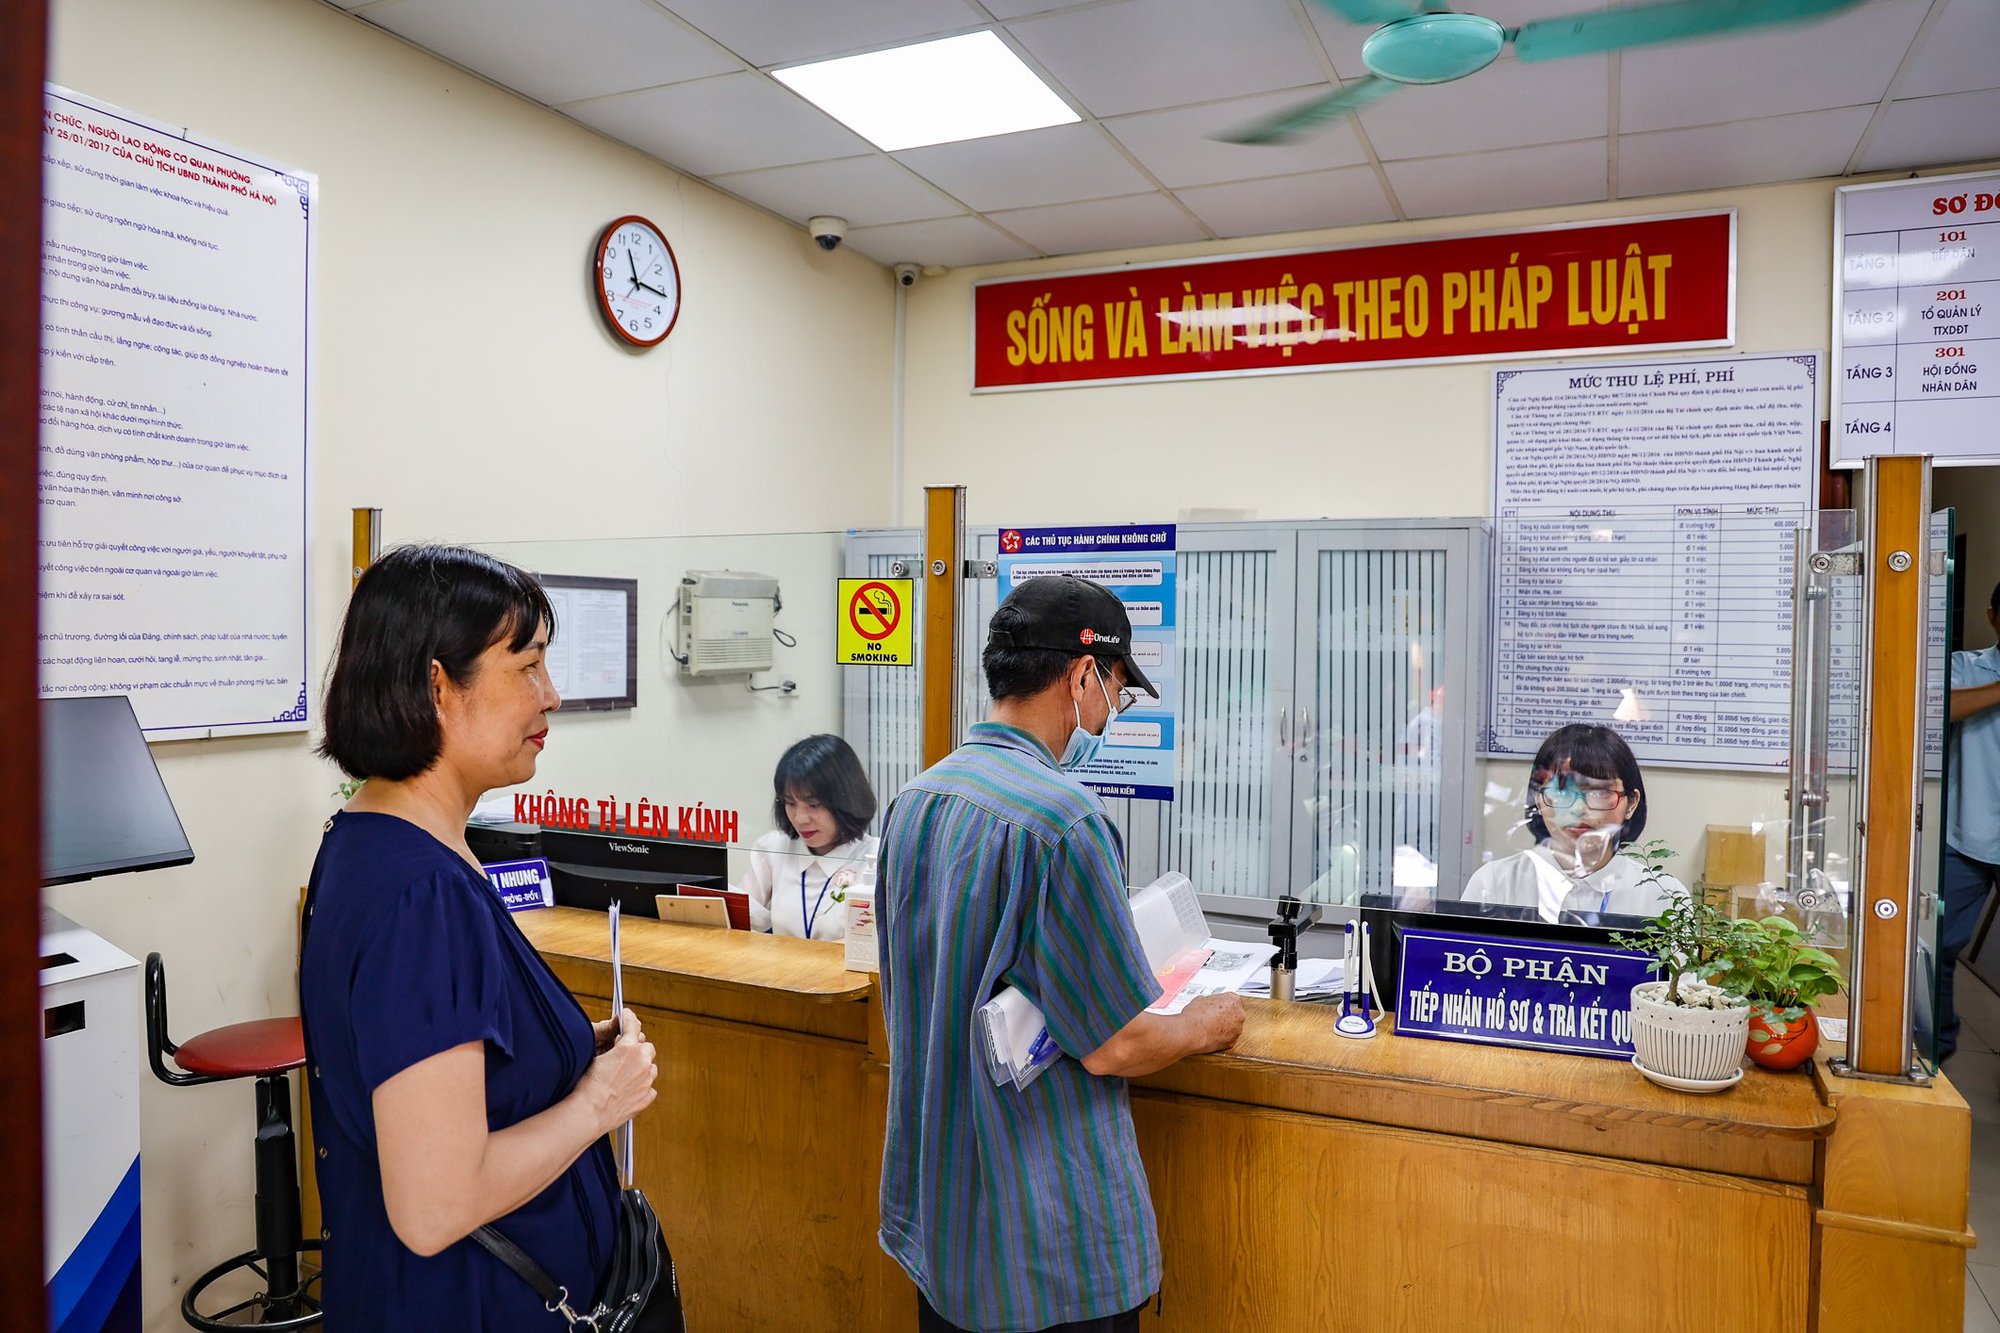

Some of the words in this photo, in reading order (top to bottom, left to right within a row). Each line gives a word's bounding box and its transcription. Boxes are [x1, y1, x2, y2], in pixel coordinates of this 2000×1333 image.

[122, 136, 140, 148] LAO
[144, 142, 171, 158] ĐỘNG
[190, 158, 214, 172] QUAN
[57, 129, 110, 152] 25/01/2017
[112, 146, 132, 160] CỦA
[135, 154, 154, 167] CHỦ
[156, 160, 175, 173] TỊCH
[178, 168, 200, 181] UBND
[202, 176, 229, 190] THÀNH
[231, 184, 248, 196] PHỐ
[250, 190, 260, 200] HÀ
[263, 195, 276, 205] NỘI
[86, 167, 103, 180] dụng
[120, 178, 134, 188] gian
[164, 190, 180, 201] khoa
[1932, 194, 1968, 216] SƠ
[50, 199, 66, 209] giao
[96, 211, 113, 223] dụng
[177, 233, 196, 245] không
[618, 233, 626, 245] 11
[631, 233, 641, 244] 12
[1939, 230, 1966, 242] 101
[606, 246, 616, 259] 10
[649, 244, 652, 254] 1
[88, 249, 106, 262] trong
[603, 267, 612, 279] 9
[654, 264, 662, 276] 2
[606, 290, 615, 301] 8
[658, 285, 666, 295] 3
[1936, 290, 1966, 302] 201
[654, 305, 661, 315] 4
[1006, 292, 1094, 366] SỐNG
[1104, 287, 1148, 359] VÀ
[1160, 281, 1234, 355] LÀM
[1242, 273, 1325, 357] VIỆC
[1333, 274, 1429, 342] THEO
[1443, 252, 1553, 335] PHÁP
[1568, 242, 1672, 334] LUẬT
[617, 309, 624, 320] 7
[1887, 312, 1894, 323] 2
[1921, 305, 1935, 320] TỔ
[1937, 306, 1968, 318] QUẢN
[1970, 303, 1982, 317] LÝ
[630, 320, 638, 331] 6
[644, 317, 652, 329] 5
[1933, 324, 1968, 335] TTXDĐT
[1935, 347, 1966, 358] 301
[1886, 367, 1893, 378] 3
[1923, 364, 1942, 378] HỘI
[1569, 374, 1602, 389] MỨC
[1606, 375, 1638, 387] THU
[1644, 370, 1664, 388] LỆ
[1668, 368, 1700, 385] PHÍ,
[1706, 366, 1735, 382] PHÍ
[1922, 381, 1952, 393] NHÂN
[1954, 380, 1977, 392] DÂN
[1884, 422, 1891, 433] 4
[126, 491, 142, 499] minh
[1025, 535, 1040, 546] CÁC
[1042, 534, 1056, 546] THỦ
[1058, 536, 1072, 547] TỤC
[1074, 534, 1094, 545] HÀNH
[1096, 533, 1120, 544] CHÍNH
[1122, 533, 1148, 543] KHÔNG
[1150, 532, 1167, 543] CHỜ
[1094, 633, 1120, 644] OneLife
[867, 643, 882, 651] NO
[851, 653, 897, 662] SMOKING
[1102, 786, 1118, 794] HOÀN
[1120, 786, 1135, 795] KIẾM
[514, 789, 589, 830] KHÔNG
[597, 795, 616, 833] TÌ
[624, 797, 669, 838] LÊN
[678, 802, 738, 843] KÍNH
[608, 842, 650, 854] ViewSonic
[500, 869, 540, 888] NHUNG
[1443, 948, 1492, 980] BỘ
[1503, 957, 1609, 988] PHẬN
[1410, 980, 1439, 1023] TIẾP
[1442, 988, 1483, 1034] NHẬN
[1486, 988, 1506, 1030] HỒ
[1509, 998, 1531, 1032] SƠ
[1532, 1003, 1544, 1034] &
[1549, 992, 1576, 1038] TRẢ
[1580, 996, 1608, 1041] KẾT
[1612, 1009, 1636, 1046] QU
